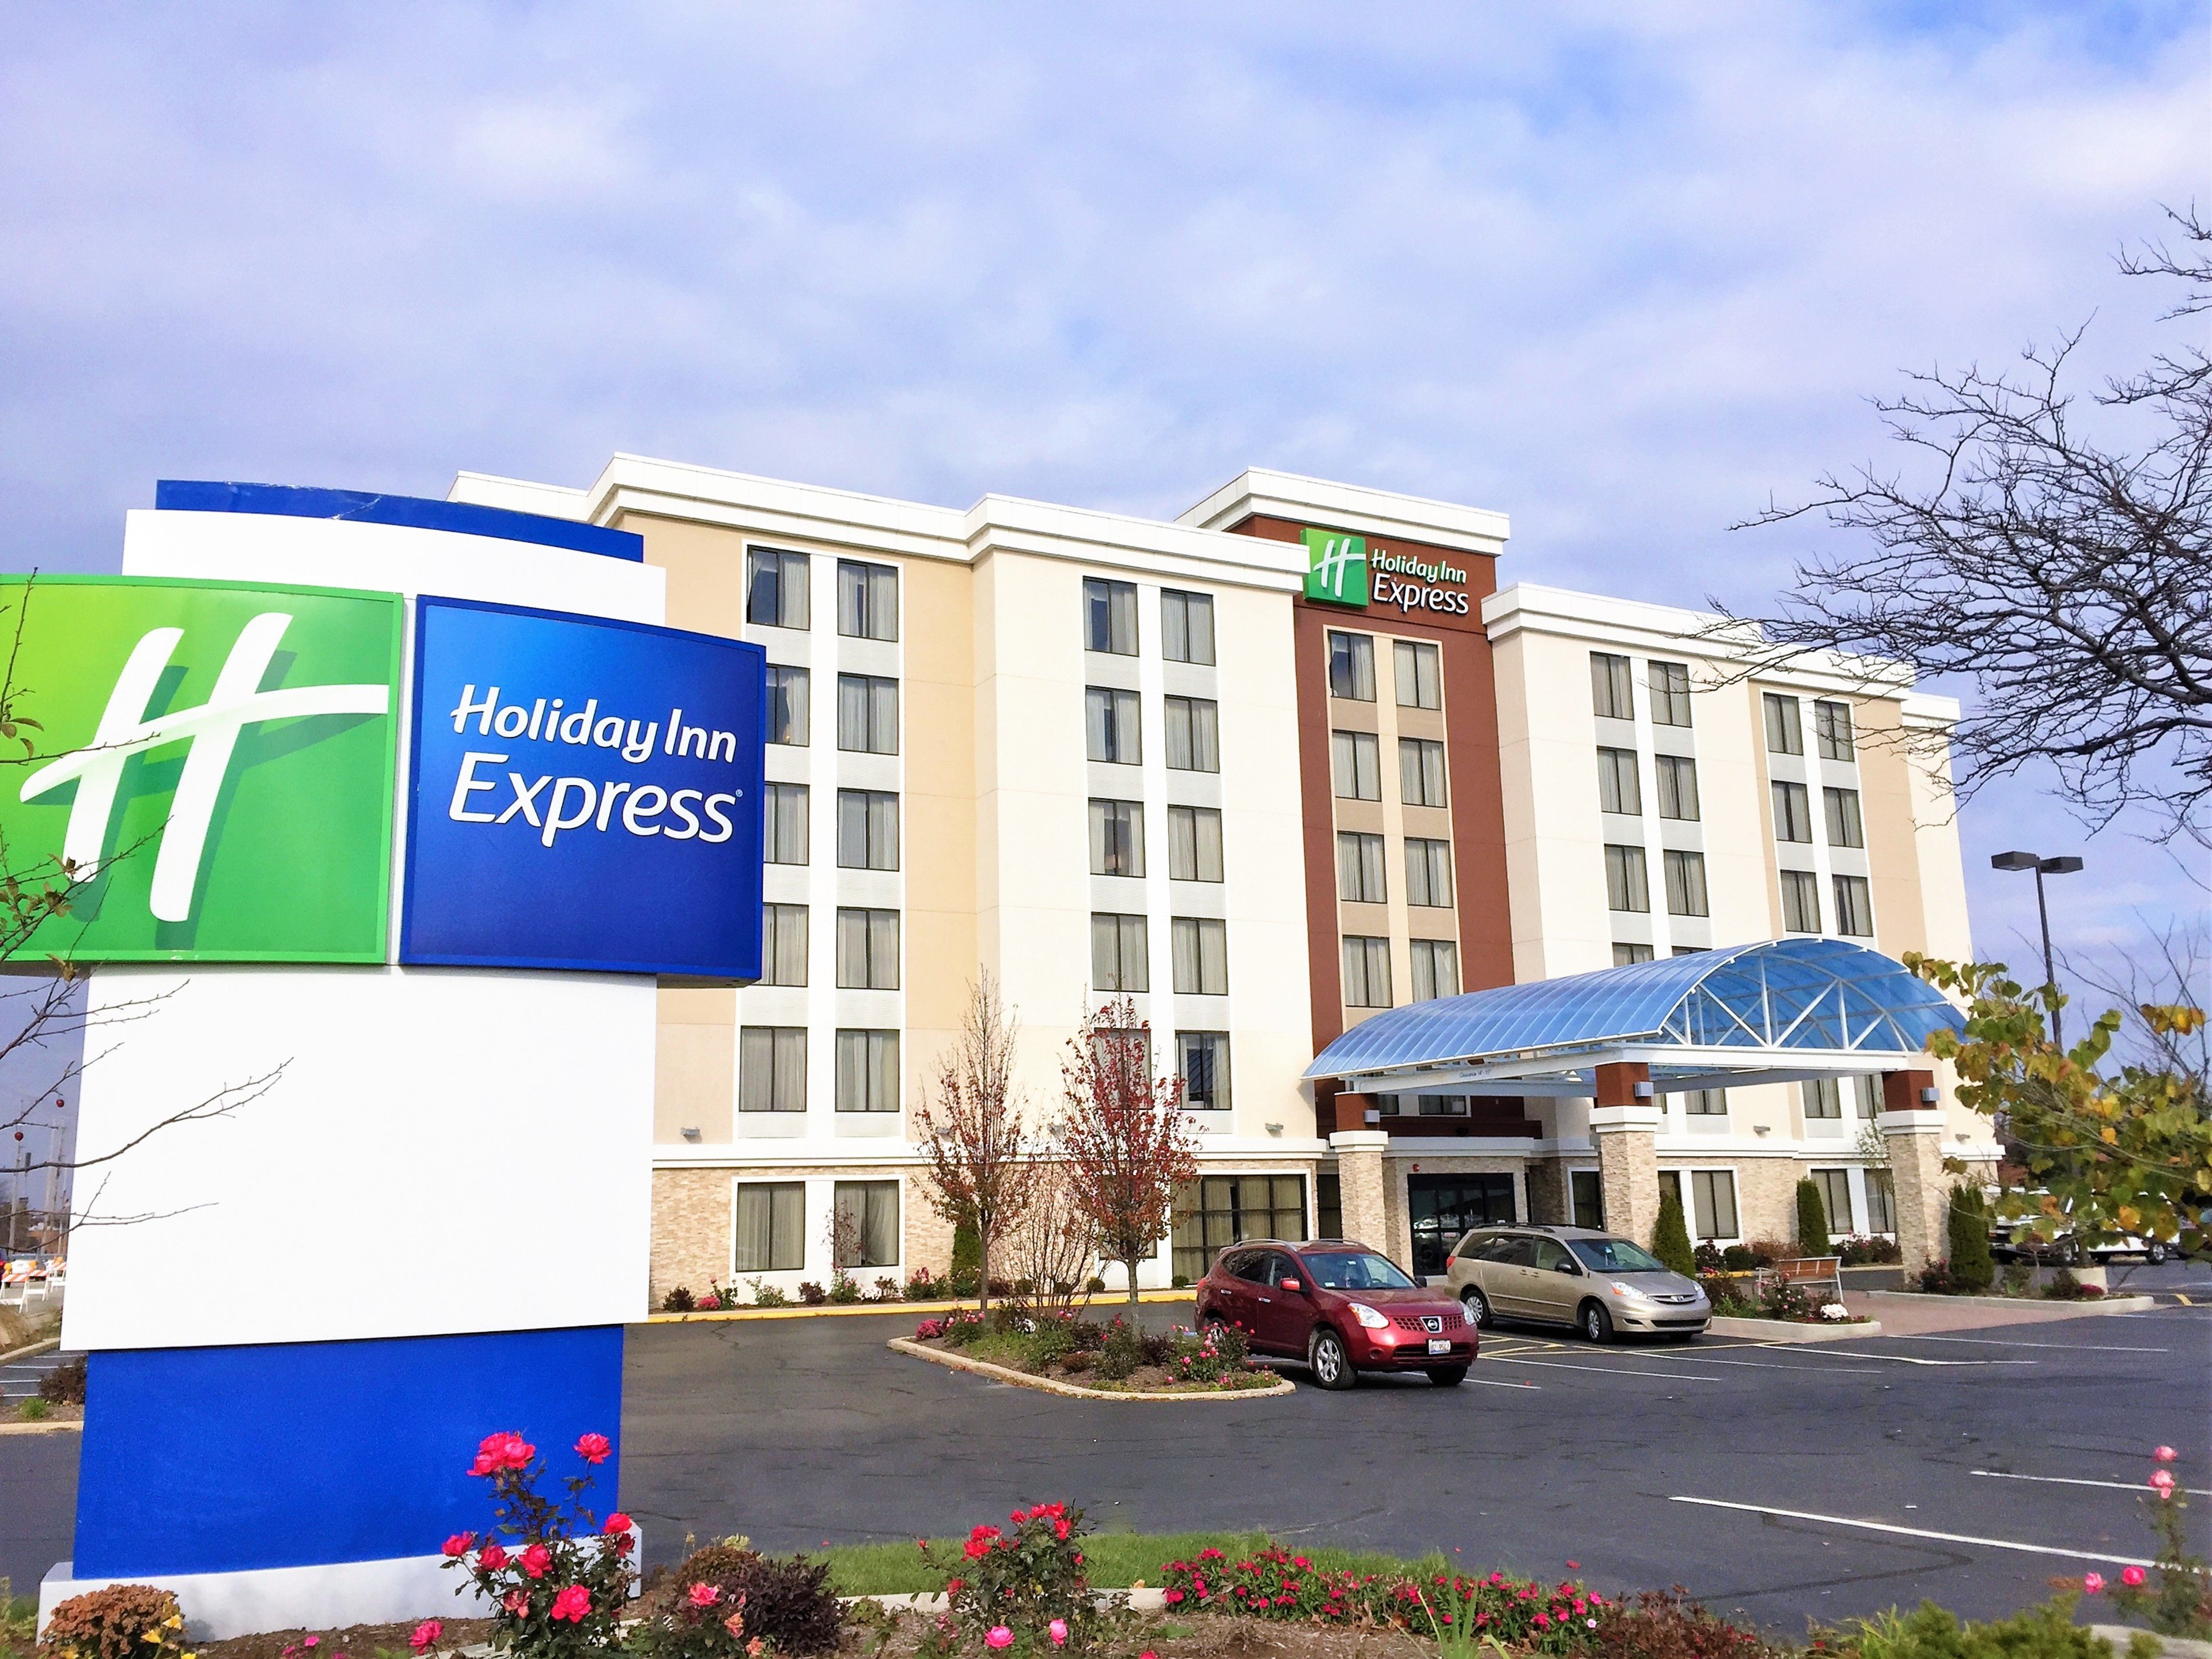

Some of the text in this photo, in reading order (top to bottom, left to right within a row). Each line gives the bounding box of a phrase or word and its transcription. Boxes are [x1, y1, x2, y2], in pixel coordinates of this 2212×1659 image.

[1370, 548, 1467, 584] Holiday Inn
[1373, 573, 1469, 614] Express
[450, 684, 737, 763] Holiday Inn
